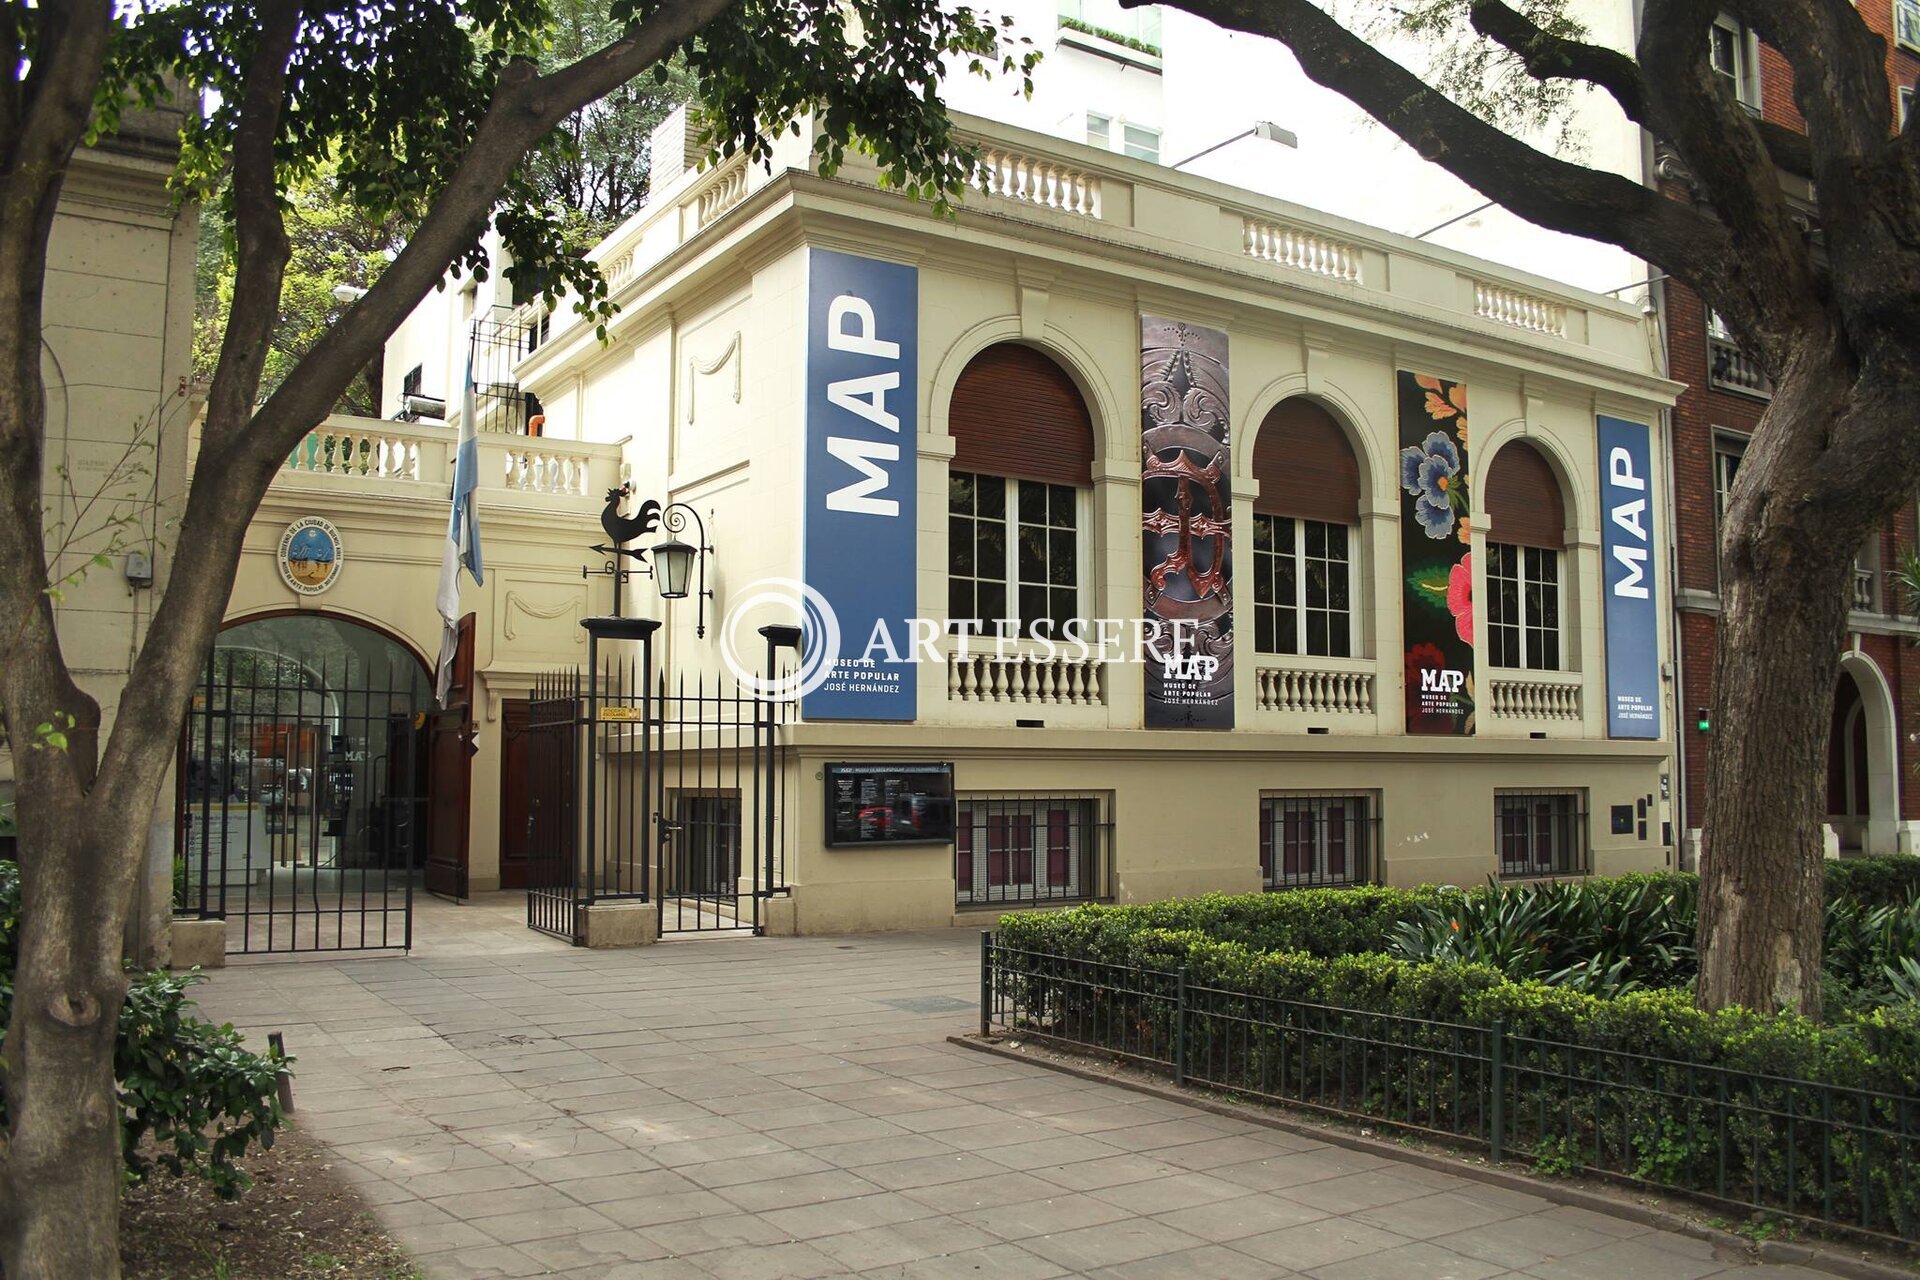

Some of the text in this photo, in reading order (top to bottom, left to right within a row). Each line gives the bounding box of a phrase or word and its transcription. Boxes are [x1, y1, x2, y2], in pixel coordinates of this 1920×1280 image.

[826, 294, 900, 517] MAP
[1609, 446, 1649, 599] MAP
[280, 534, 292, 558] GOBIERNO
[330, 529, 340, 546] BUENOS
[824, 658, 876, 668] MUSEO DE
[1163, 654, 1219, 680] MAP
[824, 670, 900, 681] ARTE POPULAR
[824, 681, 900, 694] JOSÉ HERNÁNDEZ
[1421, 669, 1464, 692] MAP
